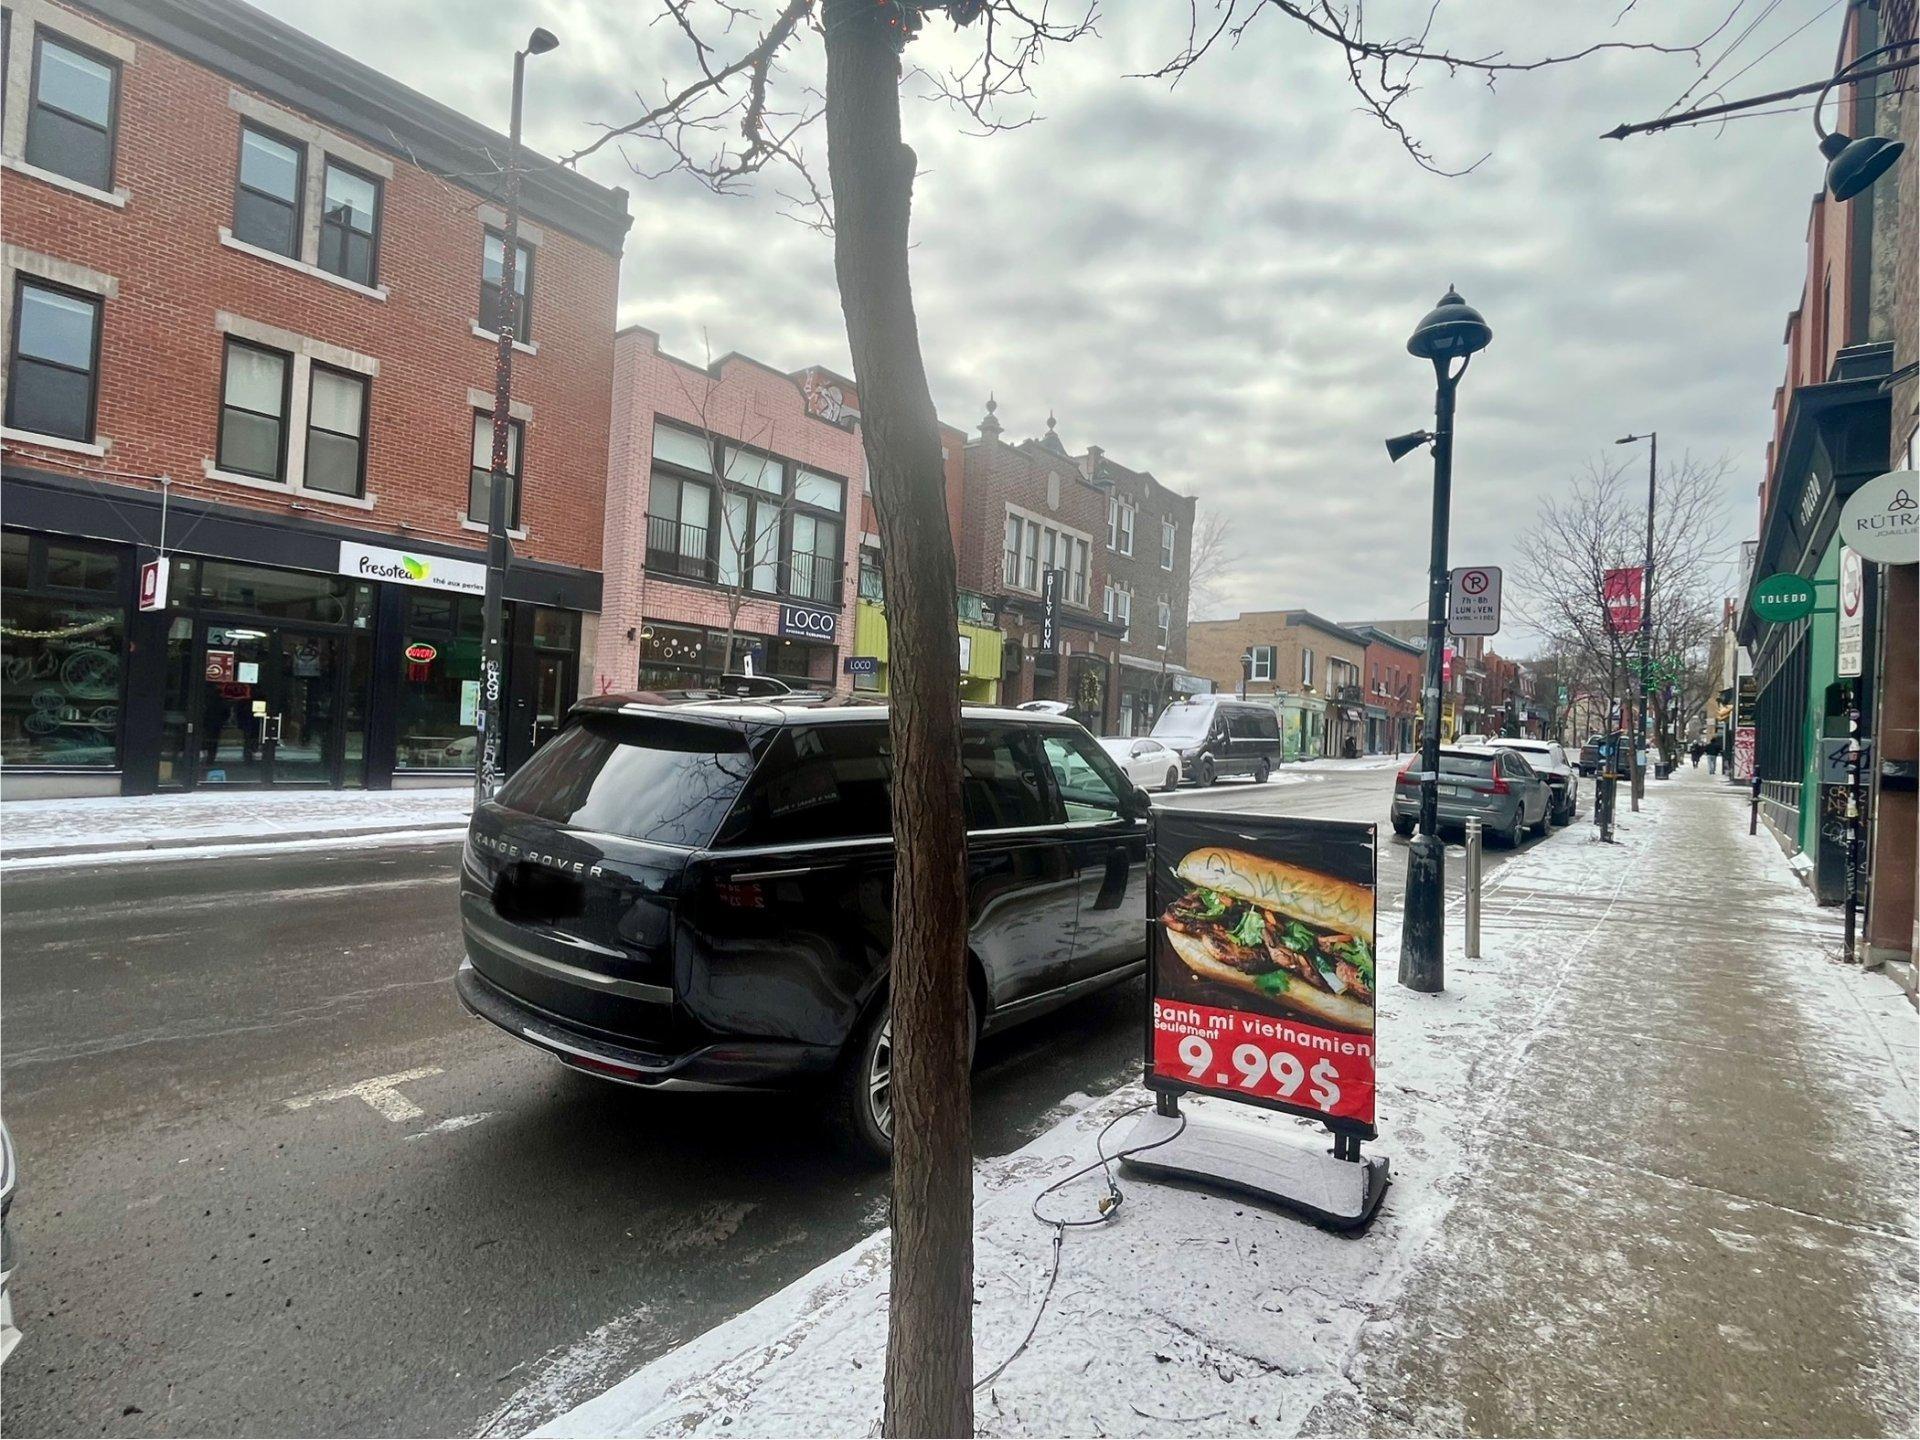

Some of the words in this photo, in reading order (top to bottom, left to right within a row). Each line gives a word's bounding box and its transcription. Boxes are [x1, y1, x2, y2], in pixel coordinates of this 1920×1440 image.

[359, 555, 415, 580] Presotea
[1760, 593, 1807, 604] TOLEDO
[786, 608, 834, 631] LOCO
[850, 660, 871, 670] LOCO
[475, 832, 518, 857] RANGE
[528, 851, 602, 878] ROVER
[1153, 1003, 1201, 1026] Banh
[1208, 1014, 1234, 1031] mi
[1242, 1017, 1371, 1057] vietnamien
[1154, 1018, 1220, 1040] Seulement
[1178, 1034, 1342, 1112] 9.99$
